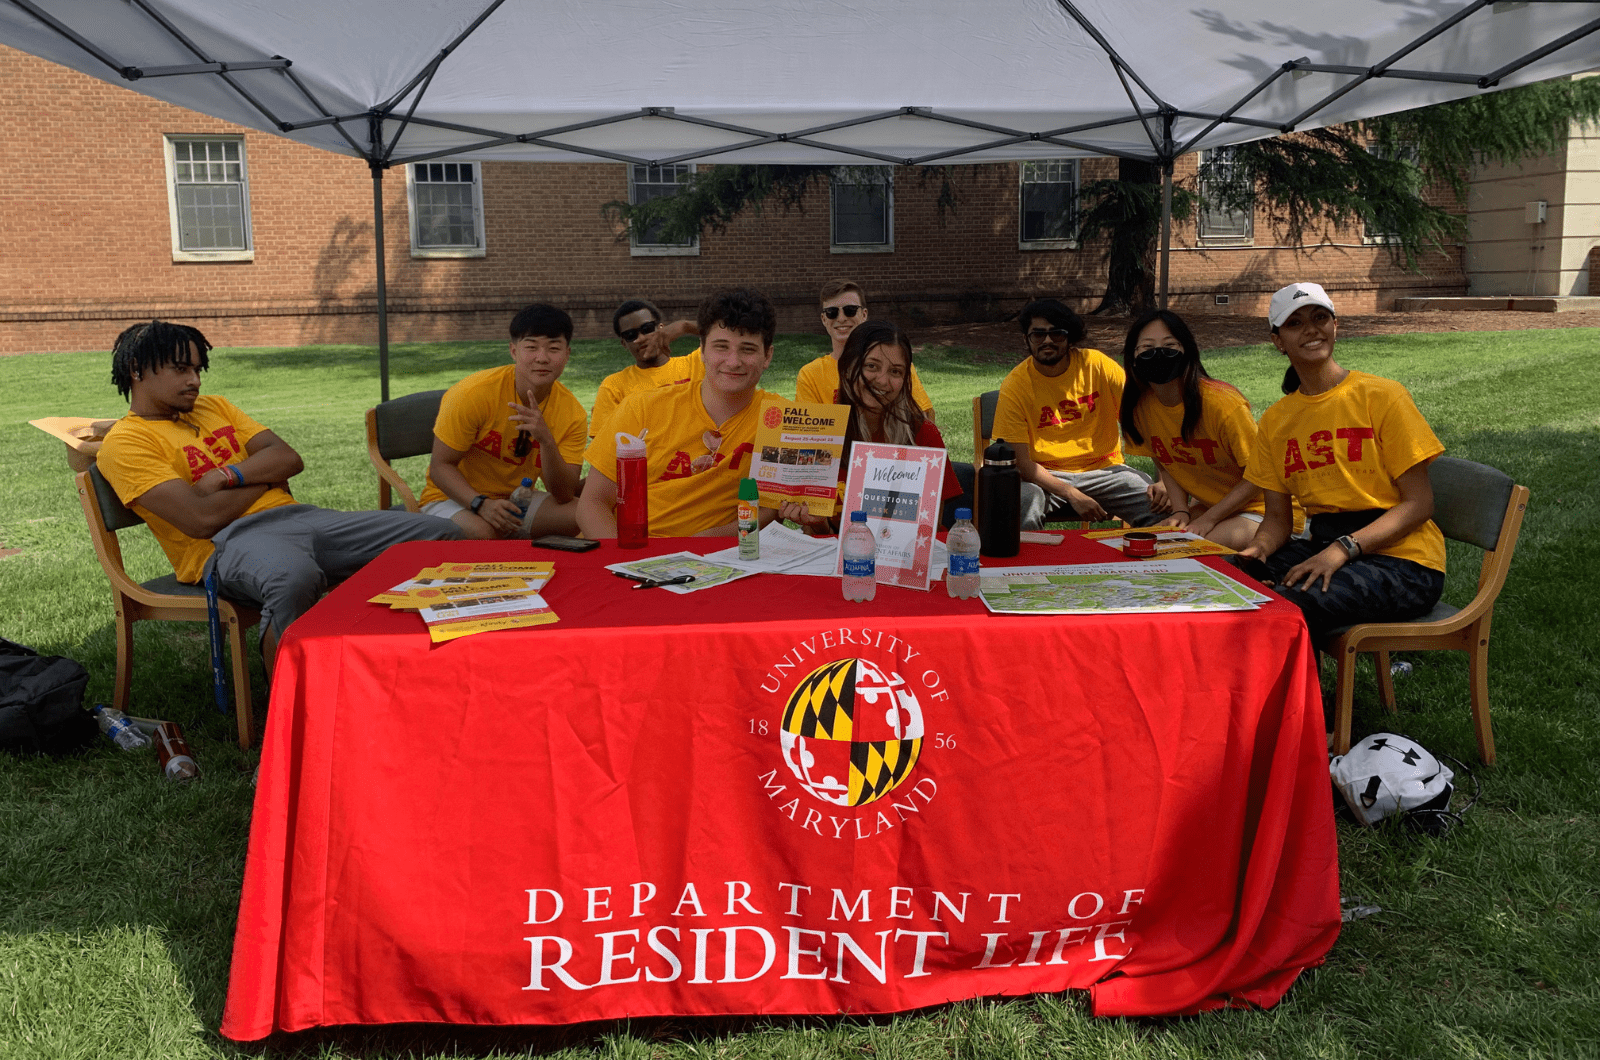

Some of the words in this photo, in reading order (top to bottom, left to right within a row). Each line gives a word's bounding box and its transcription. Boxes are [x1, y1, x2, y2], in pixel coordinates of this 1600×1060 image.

[783, 415, 836, 427] WELCOME
[784, 407, 810, 417] FALL
[1037, 391, 1100, 428] AST
[182, 425, 240, 482] AST
[1151, 435, 1219, 466] AST
[1284, 427, 1374, 479] AST
[758, 470, 776, 479] US!
[759, 465, 777, 473] JOIN
[873, 465, 921, 482] Welcome!
[864, 493, 919, 506] QUESTIONS?
[872, 506, 889, 515] ASK
[893, 508, 907, 516] US!
[738, 509, 752, 518] OFF!
[887, 549, 911, 558] AFFAIRS
[760, 628, 920, 693] UNIVERSITY
[922, 670, 950, 702] OF
[748, 718, 769, 735] 18
[934, 733, 957, 750] 56
[757, 768, 937, 840] MARYLAND
[523, 880, 1021, 925] DEPARTMENT
[1067, 888, 1146, 920] OF
[521, 925, 950, 991] RESIDENT
[972, 919, 1133, 969] LIFE
